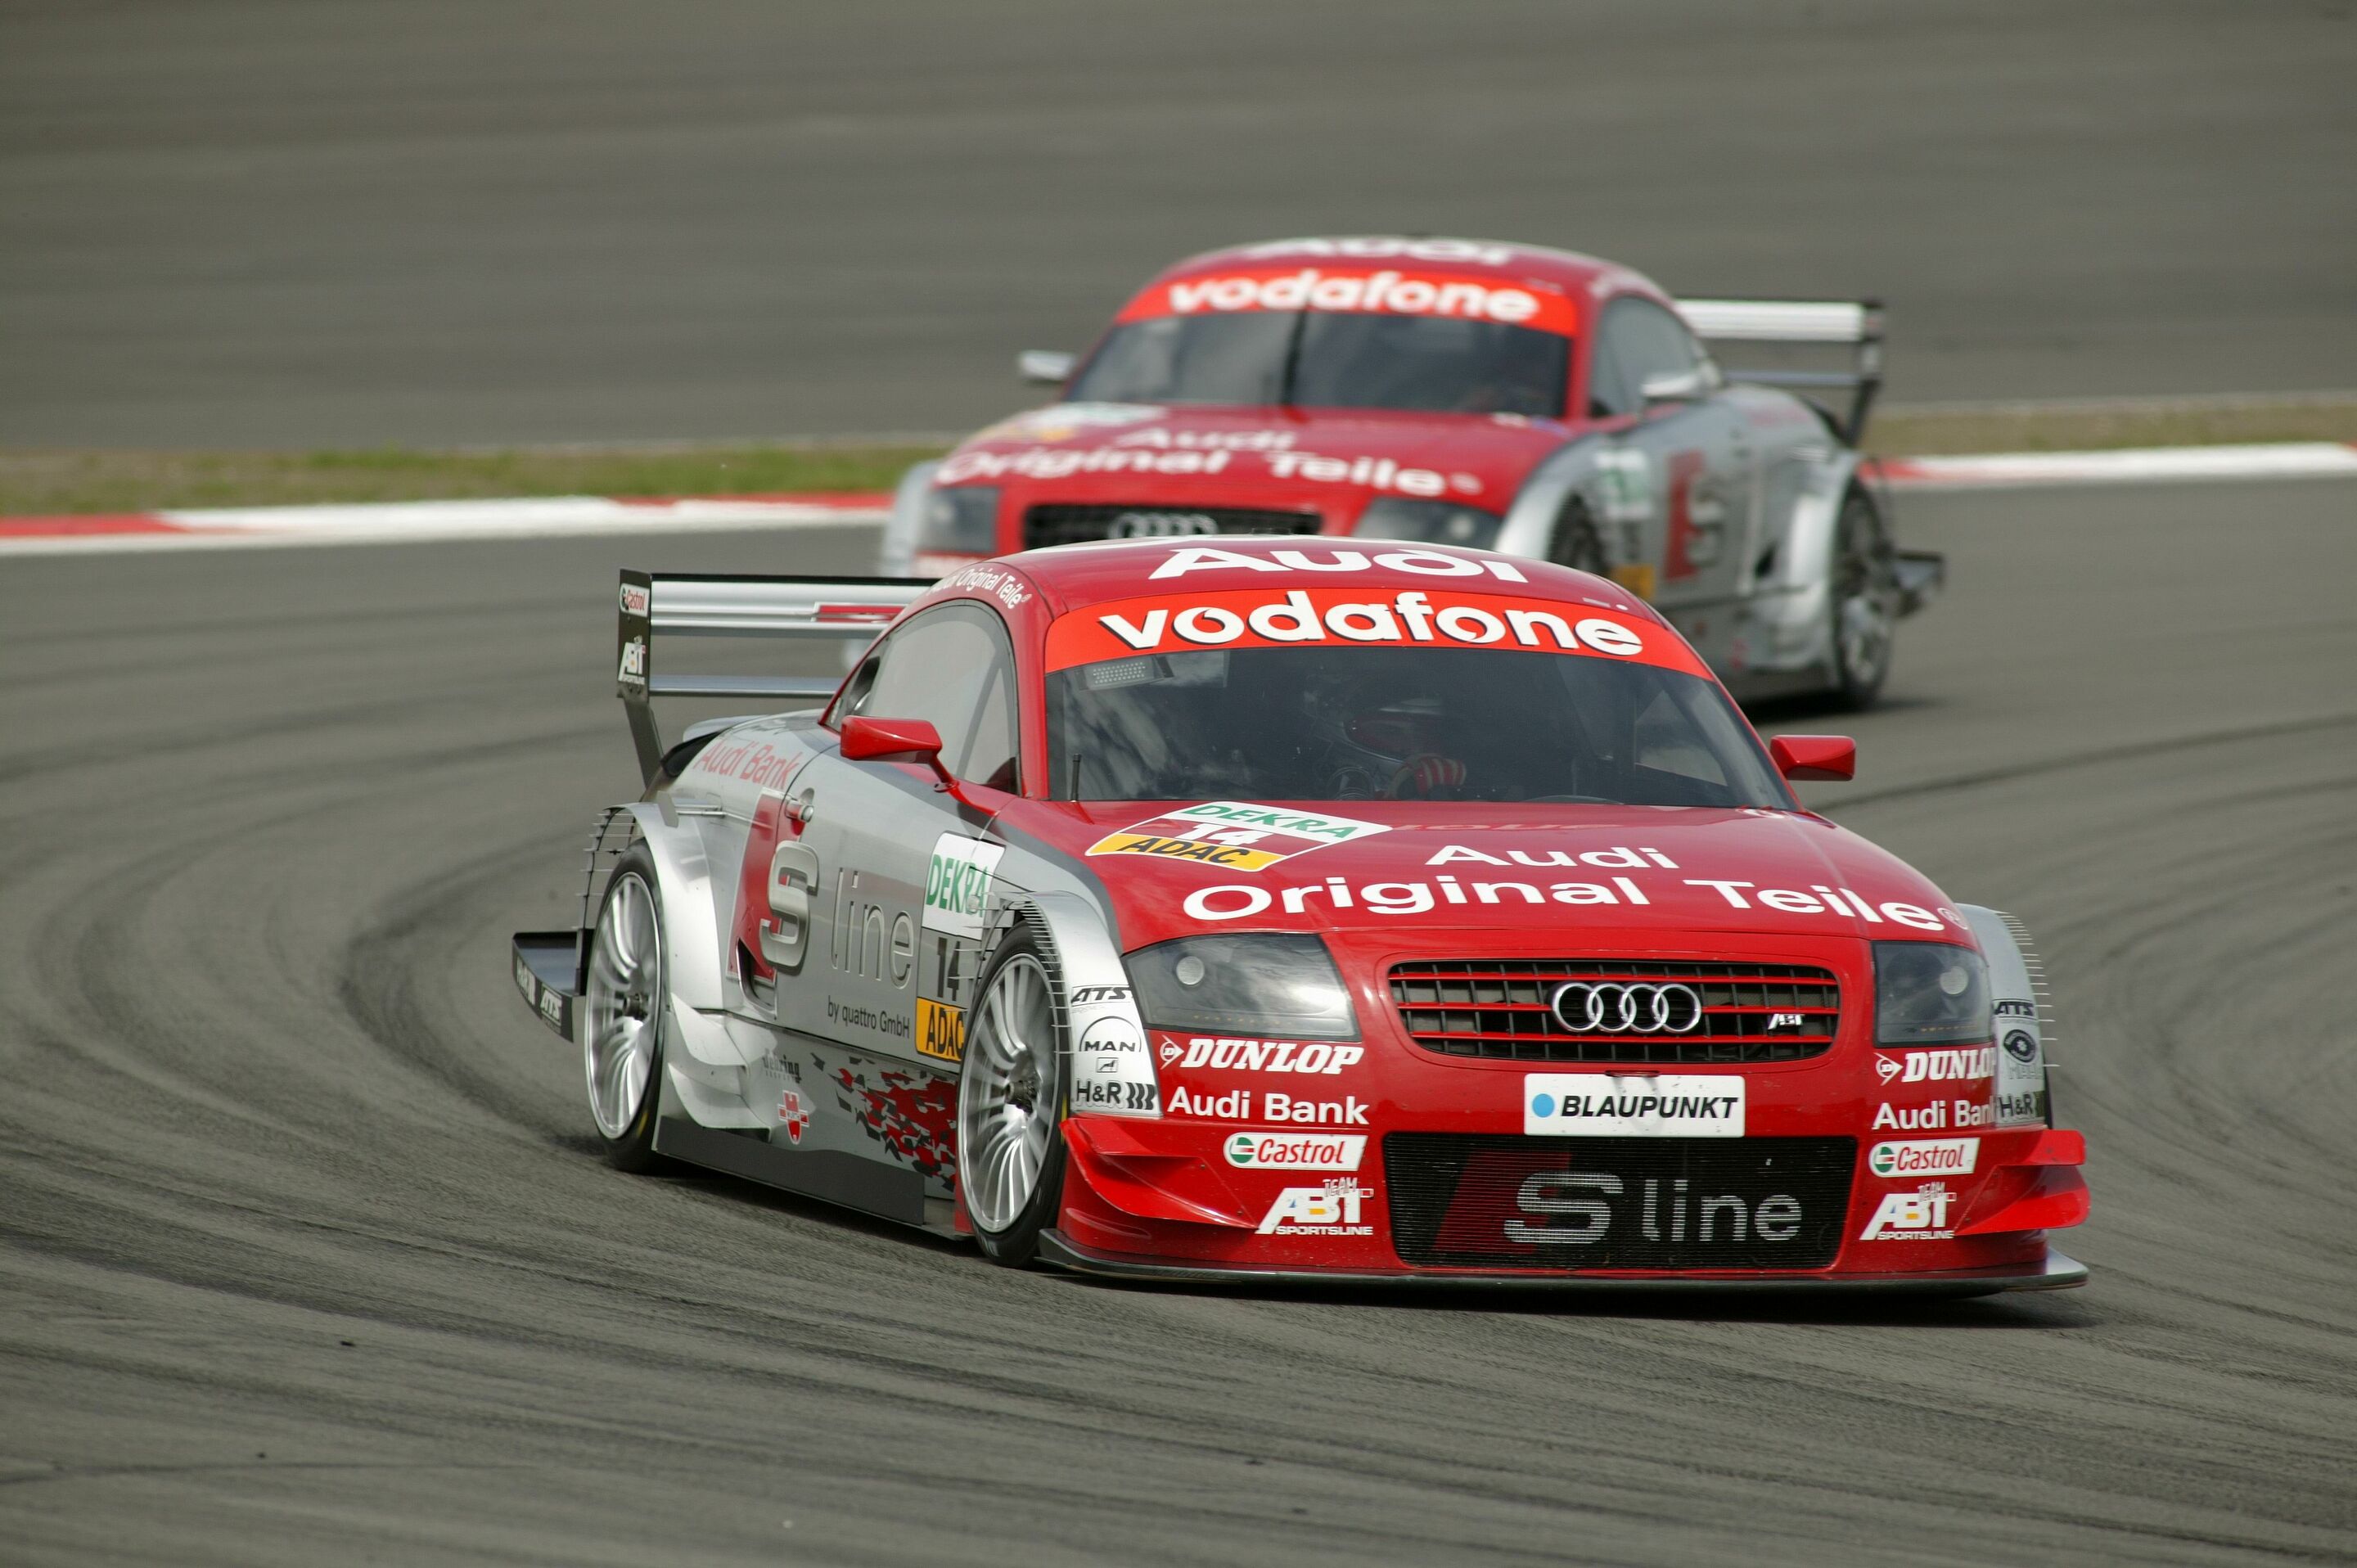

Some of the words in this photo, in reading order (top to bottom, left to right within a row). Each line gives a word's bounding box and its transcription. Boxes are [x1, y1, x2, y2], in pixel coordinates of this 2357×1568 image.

[1169, 268, 1540, 322] vodafone
[935, 447, 1229, 483] Original
[956, 566, 1003, 592] Original
[1147, 547, 1529, 583] Audi
[1098, 590, 1644, 656] vodafone
[692, 737, 759, 777] Audi
[739, 744, 803, 790] Bank
[1174, 822, 1274, 846] 14
[1181, 804, 1361, 840] DEKRA
[1117, 837, 1250, 863] ADAC
[1425, 845, 1680, 868] Audi
[926, 854, 989, 918] DEKRA
[1183, 876, 1652, 921] Original
[759, 840, 819, 976] S
[831, 867, 914, 989] line
[937, 936, 961, 1002] 14
[1071, 987, 1132, 1003] ATS
[1994, 1001, 2035, 1016] ATS
[827, 994, 840, 1024] by
[842, 1006, 877, 1030] quattro
[880, 1010, 910, 1039] GmbH
[1768, 1013, 1806, 1030] ABT
[926, 1004, 966, 1060] ADAC
[1084, 1040, 1136, 1052] MAN
[1179, 1039, 1365, 1075] DUNLOP
[1076, 1080, 1122, 1104] H&R
[1167, 1086, 1251, 1120] Audi
[1264, 1093, 1370, 1124] Bank
[1999, 1093, 2033, 1119] H&R
[1561, 1095, 1738, 1119] BLAUPUNKT
[1872, 1101, 1946, 1130] Audi
[1258, 1138, 1346, 1164] Castrol
[1897, 1144, 1965, 1171] Castrol
[1323, 1177, 1359, 1197] TEAM
[1917, 1182, 1946, 1202] TEAM
[1255, 1187, 1362, 1234] ABT
[1503, 1172, 1625, 1244] S
[1642, 1179, 1802, 1241] line
[1859, 1192, 1948, 1241] ABT
[1275, 1226, 1374, 1236] SPORTSLINE
[1877, 1230, 1955, 1241] SPORTSLINE
